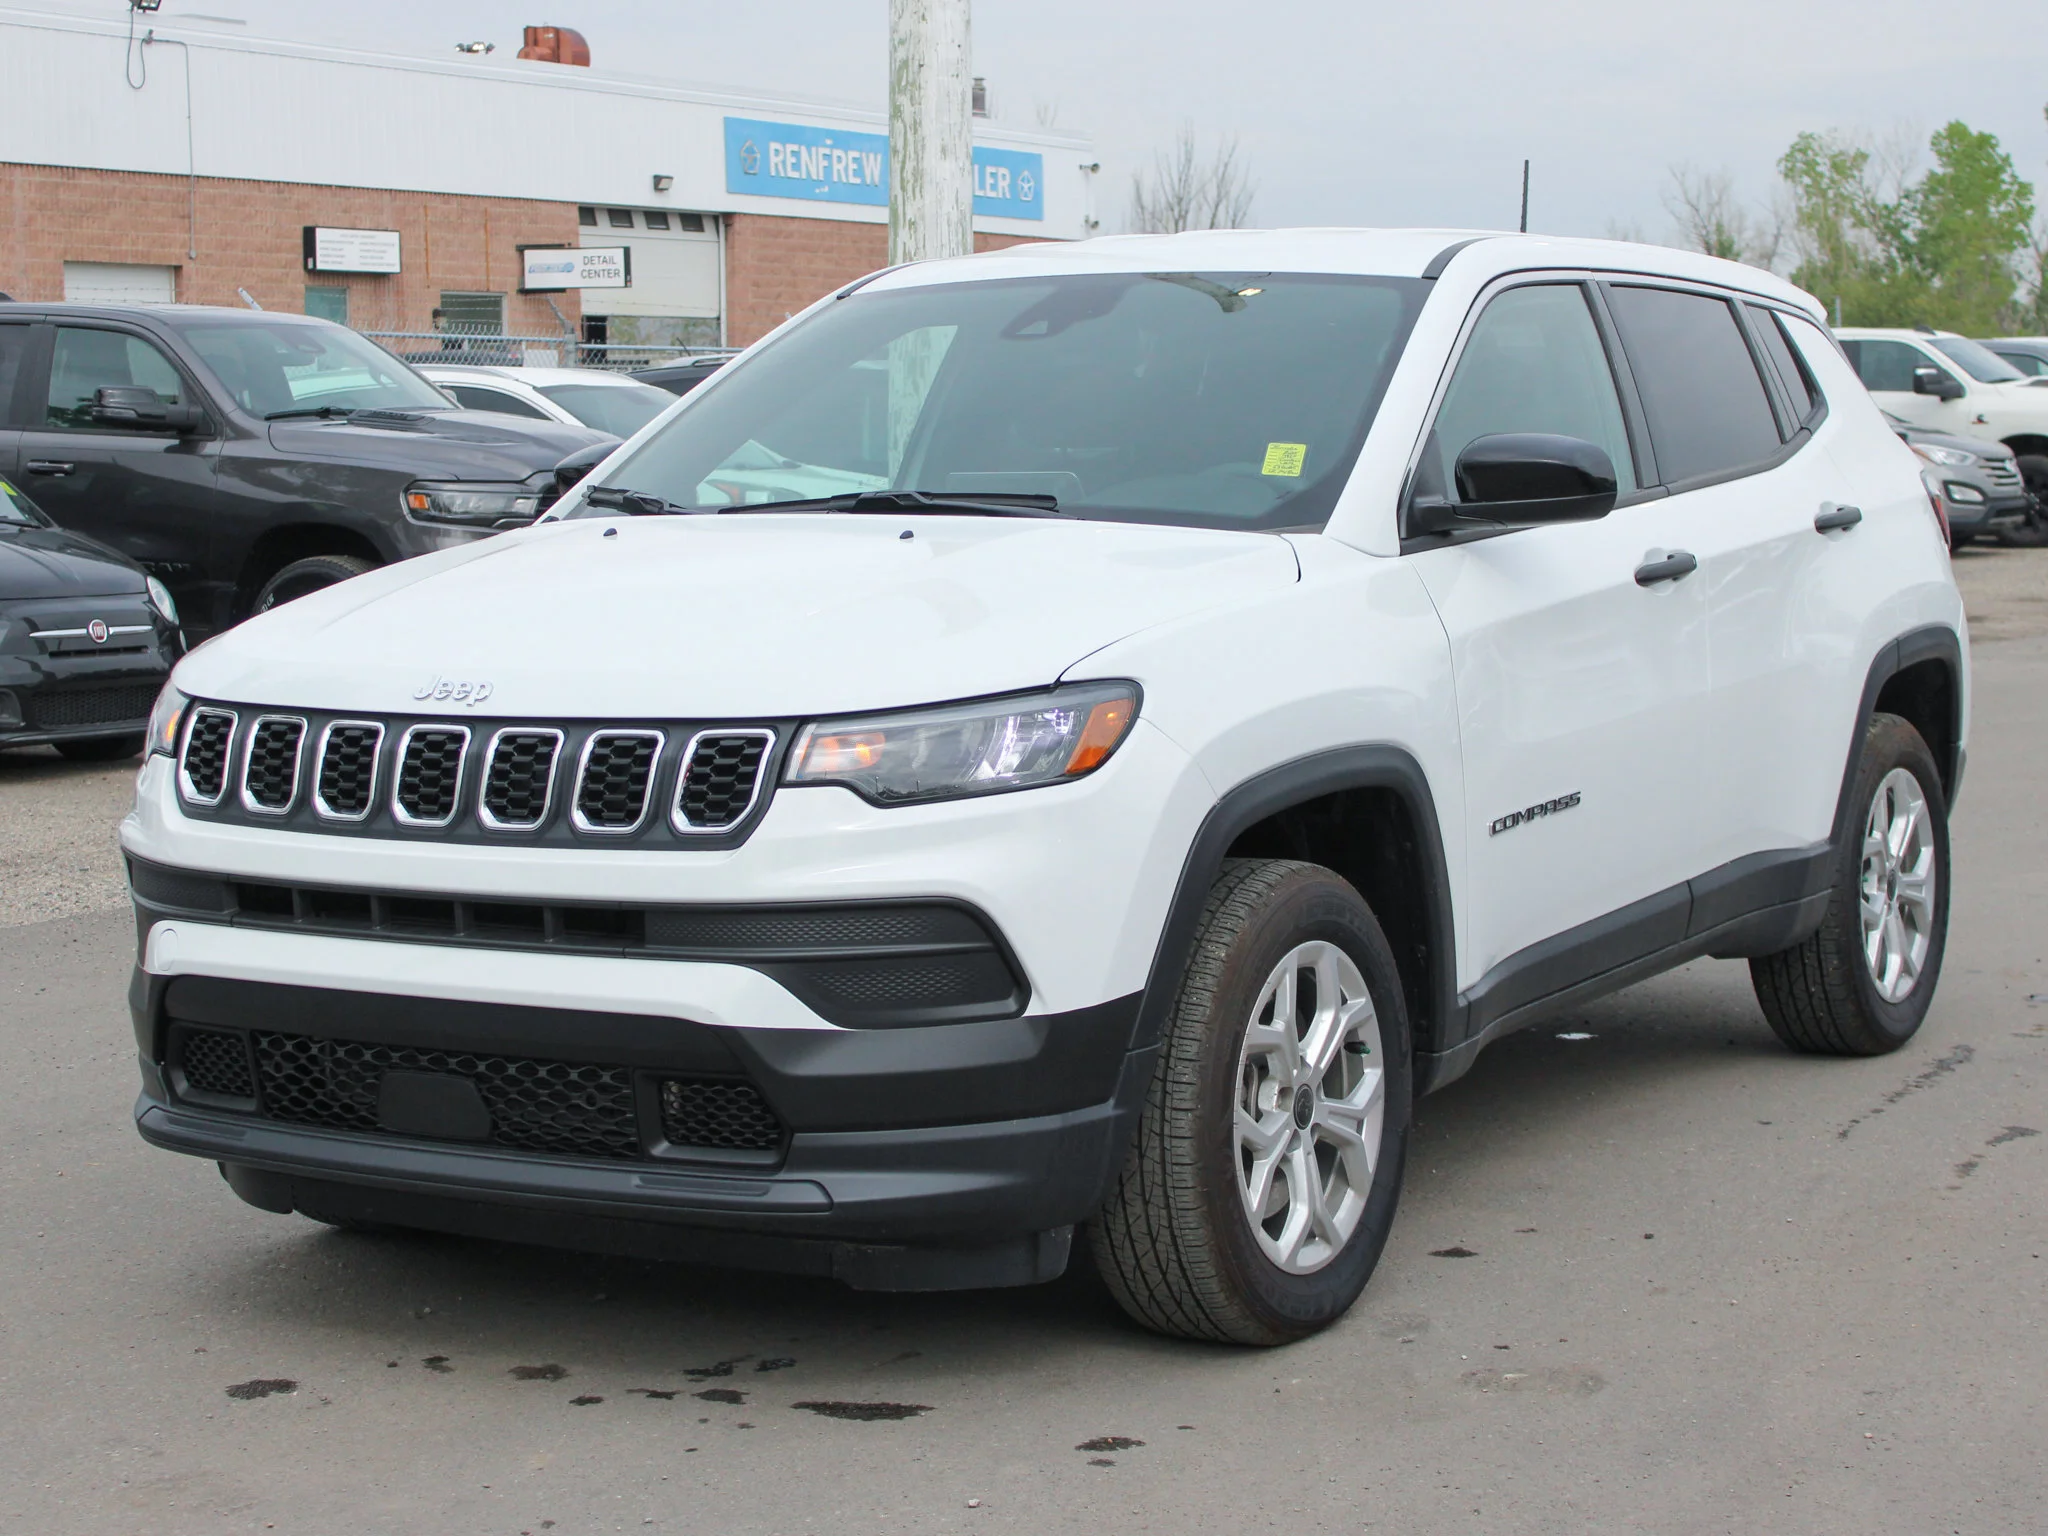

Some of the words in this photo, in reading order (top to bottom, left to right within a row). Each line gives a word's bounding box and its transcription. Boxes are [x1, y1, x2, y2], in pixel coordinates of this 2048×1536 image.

[768, 141, 882, 187] RENFREW
[580, 268, 621, 280] CENTER
[582, 255, 617, 266] DETAIL
[413, 675, 494, 707] Jeep
[1489, 791, 1581, 837] COMPASS
